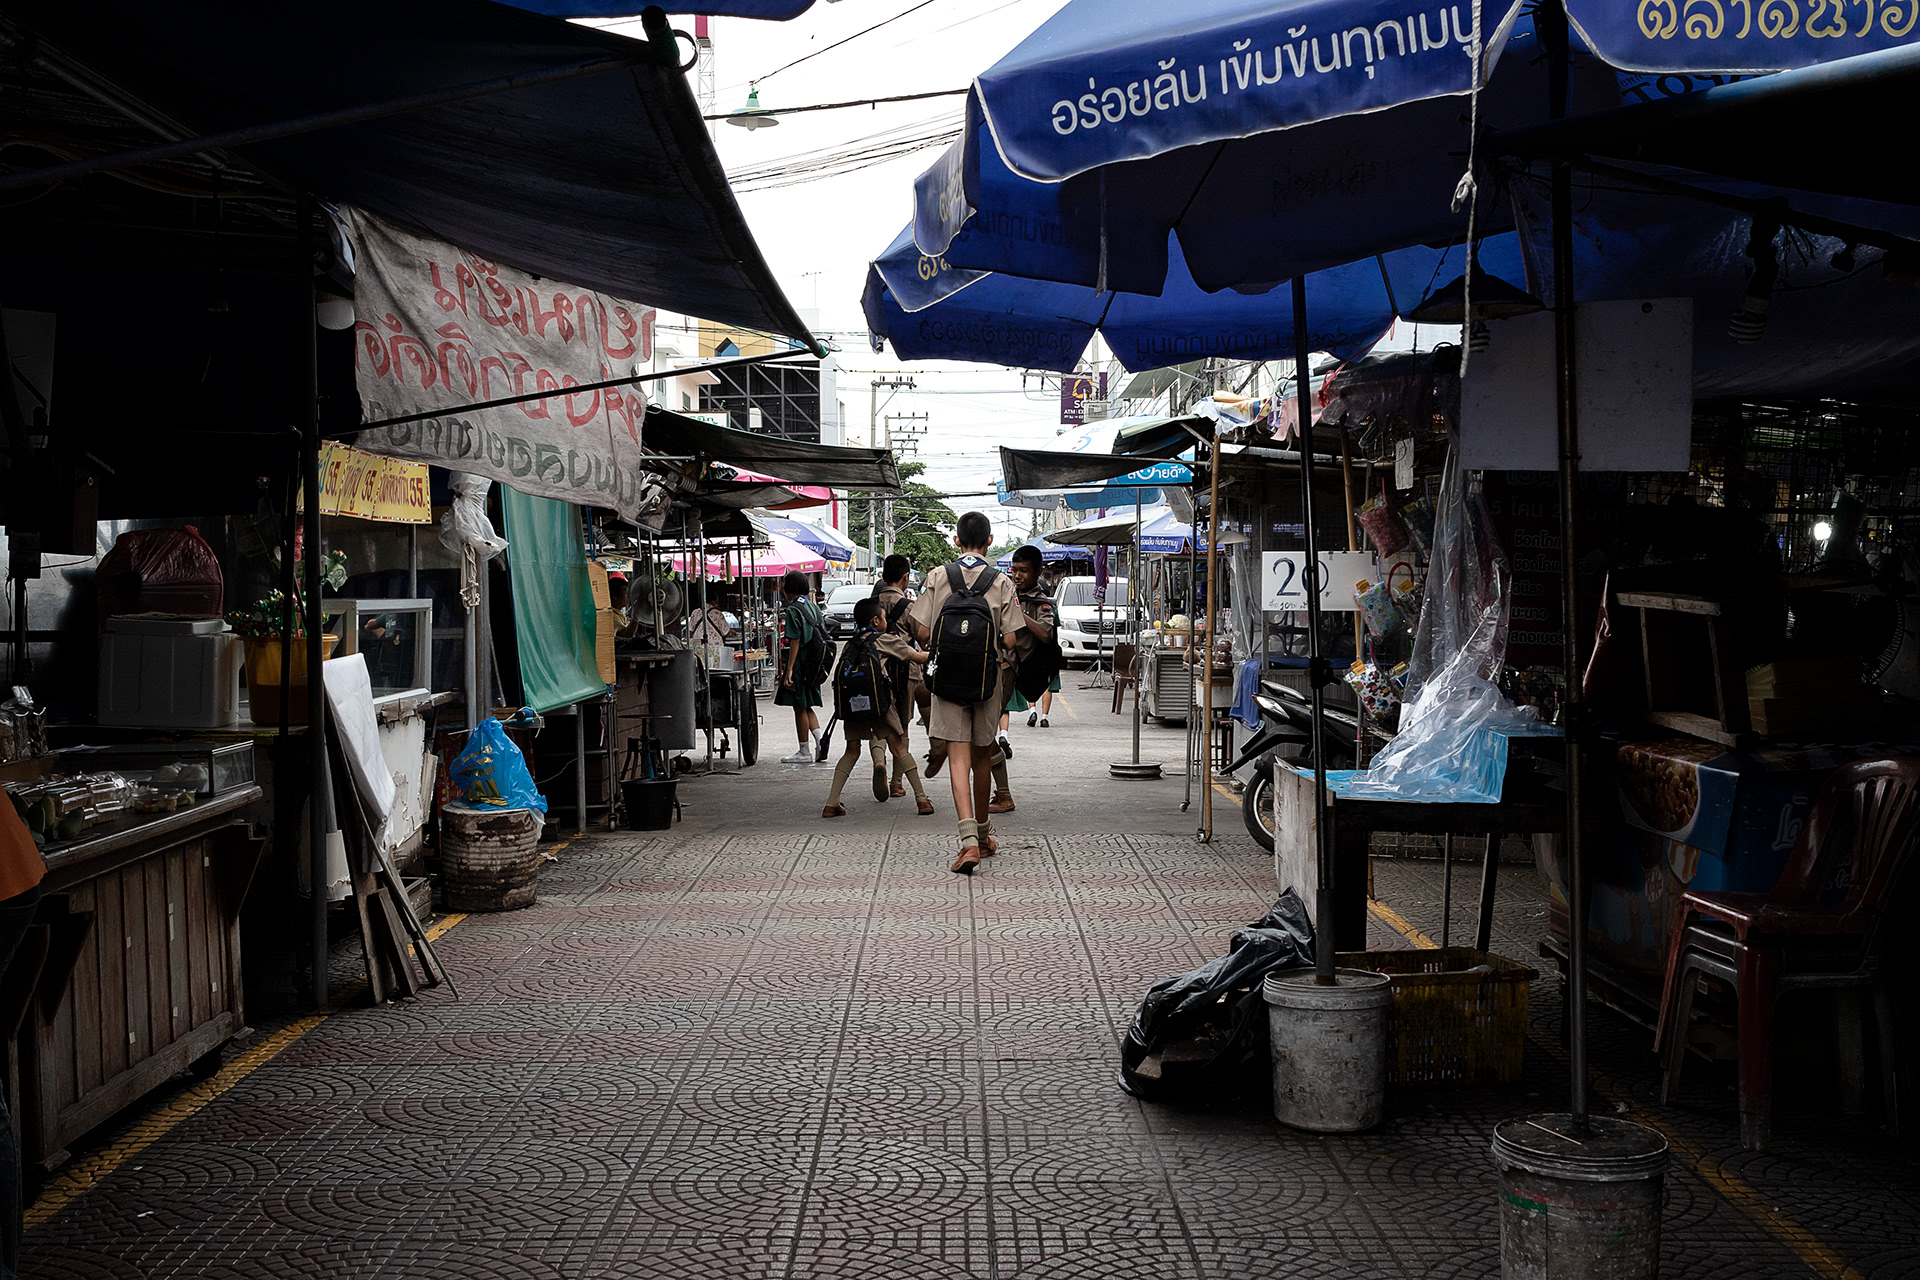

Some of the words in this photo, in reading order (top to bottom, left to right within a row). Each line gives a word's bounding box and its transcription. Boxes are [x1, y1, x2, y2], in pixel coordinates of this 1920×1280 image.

[1052, 57, 1206, 135] อร่อยล้น
[1220, 5, 1482, 95] เข้มข้นทุกเมนู
[1510, 495, 1544, 518] โคน
[1510, 606, 1548, 622] มะนาว
